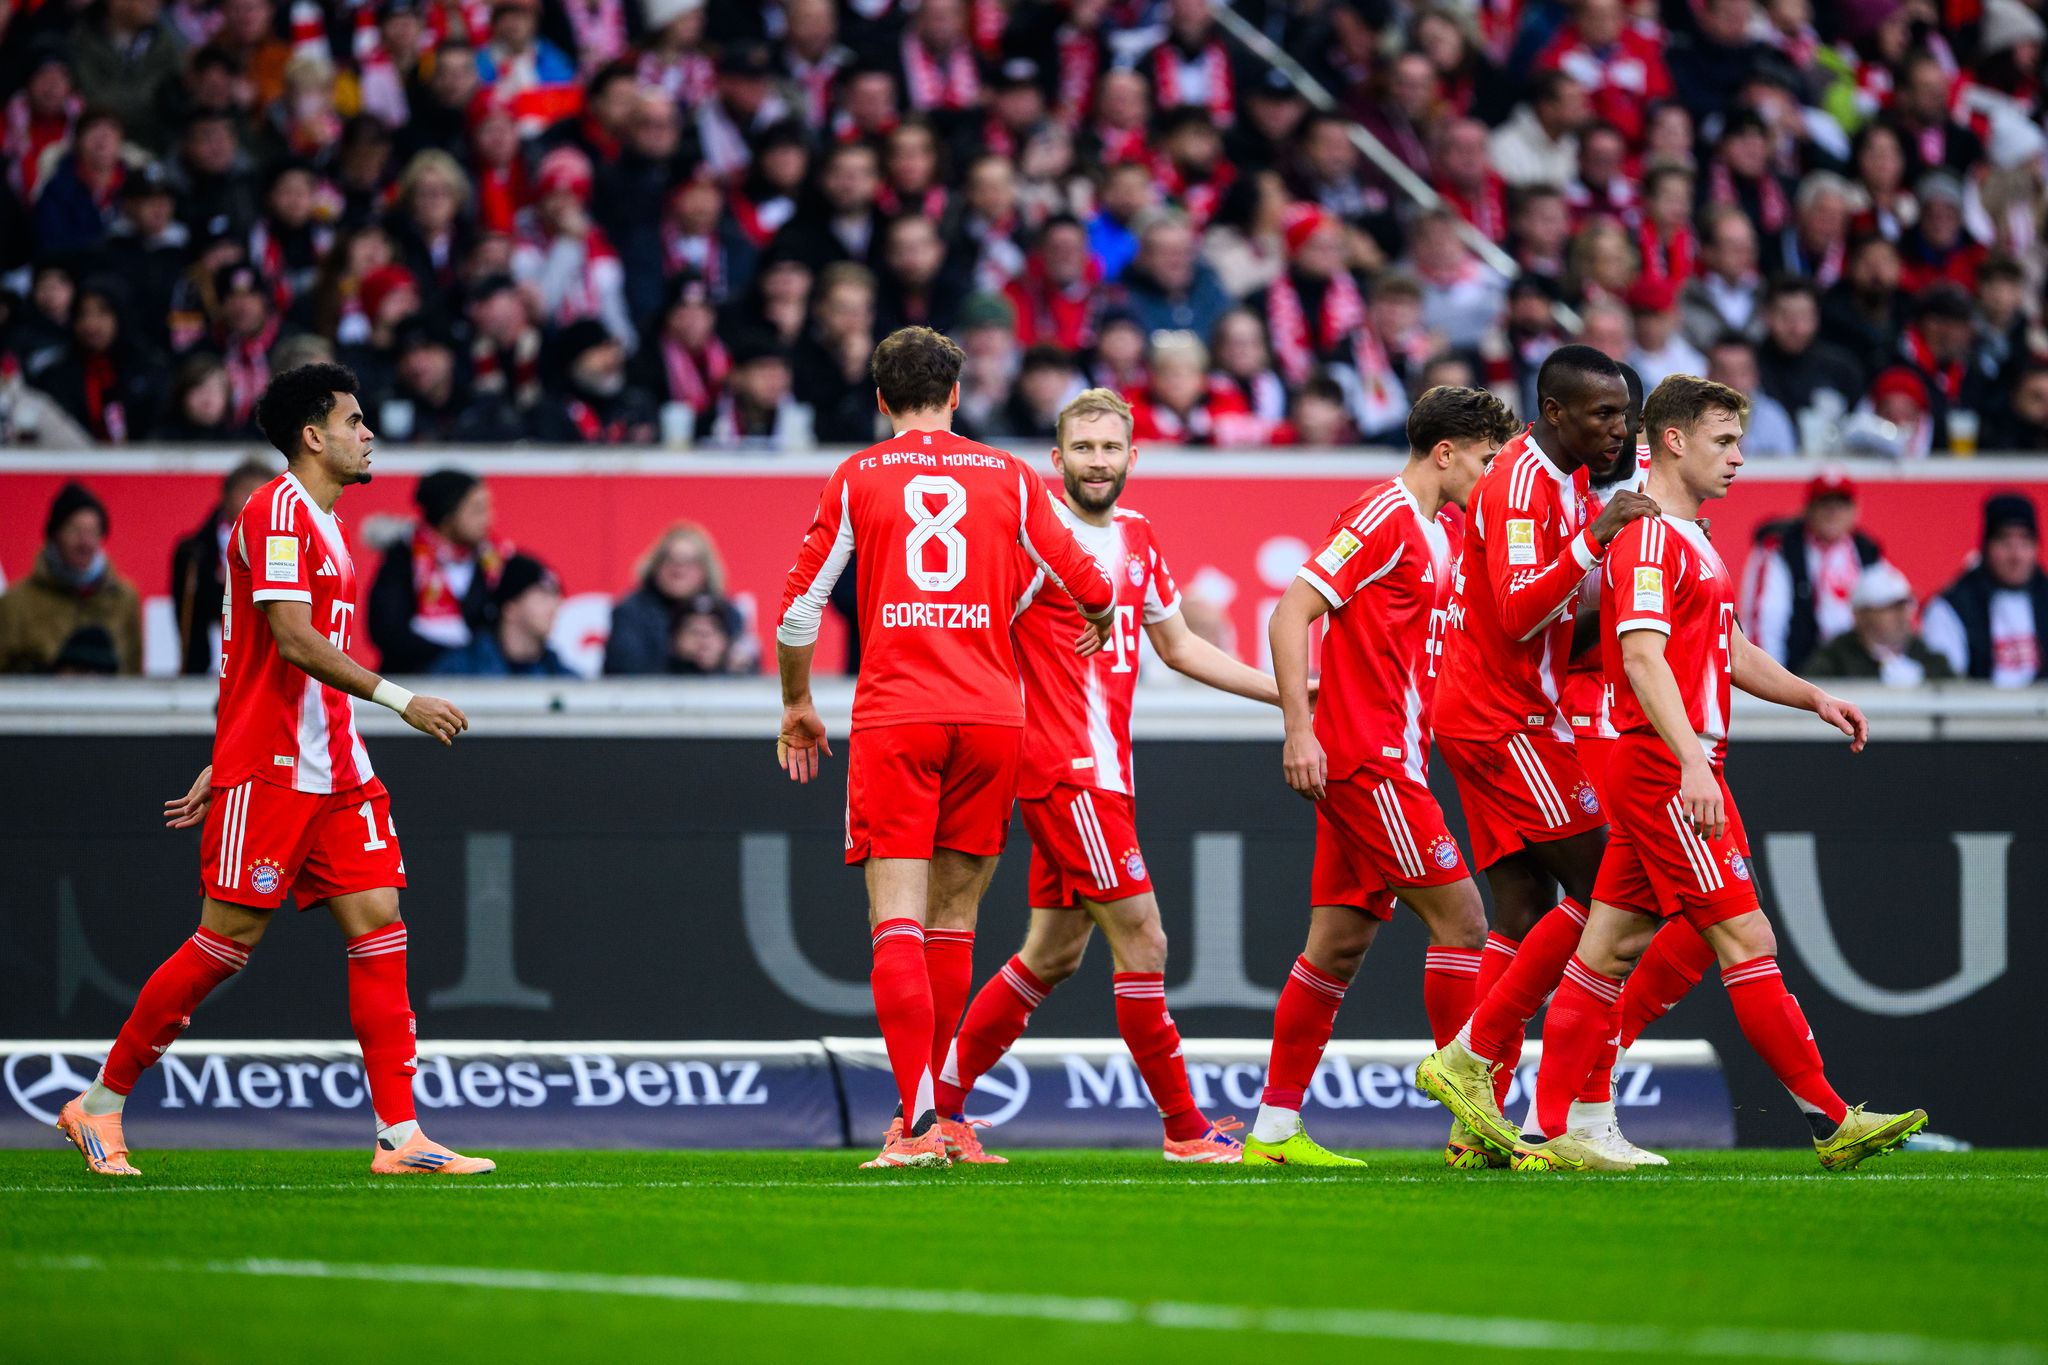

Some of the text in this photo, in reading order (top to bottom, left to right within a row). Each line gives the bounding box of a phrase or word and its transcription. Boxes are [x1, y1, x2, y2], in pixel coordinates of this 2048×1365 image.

[859, 457, 877, 471] FC
[882, 452, 937, 467] BAYERN
[903, 474, 967, 592] 8
[882, 602, 990, 629] GORETZKA
[160, 1054, 768, 1109] Mercdes-Benz
